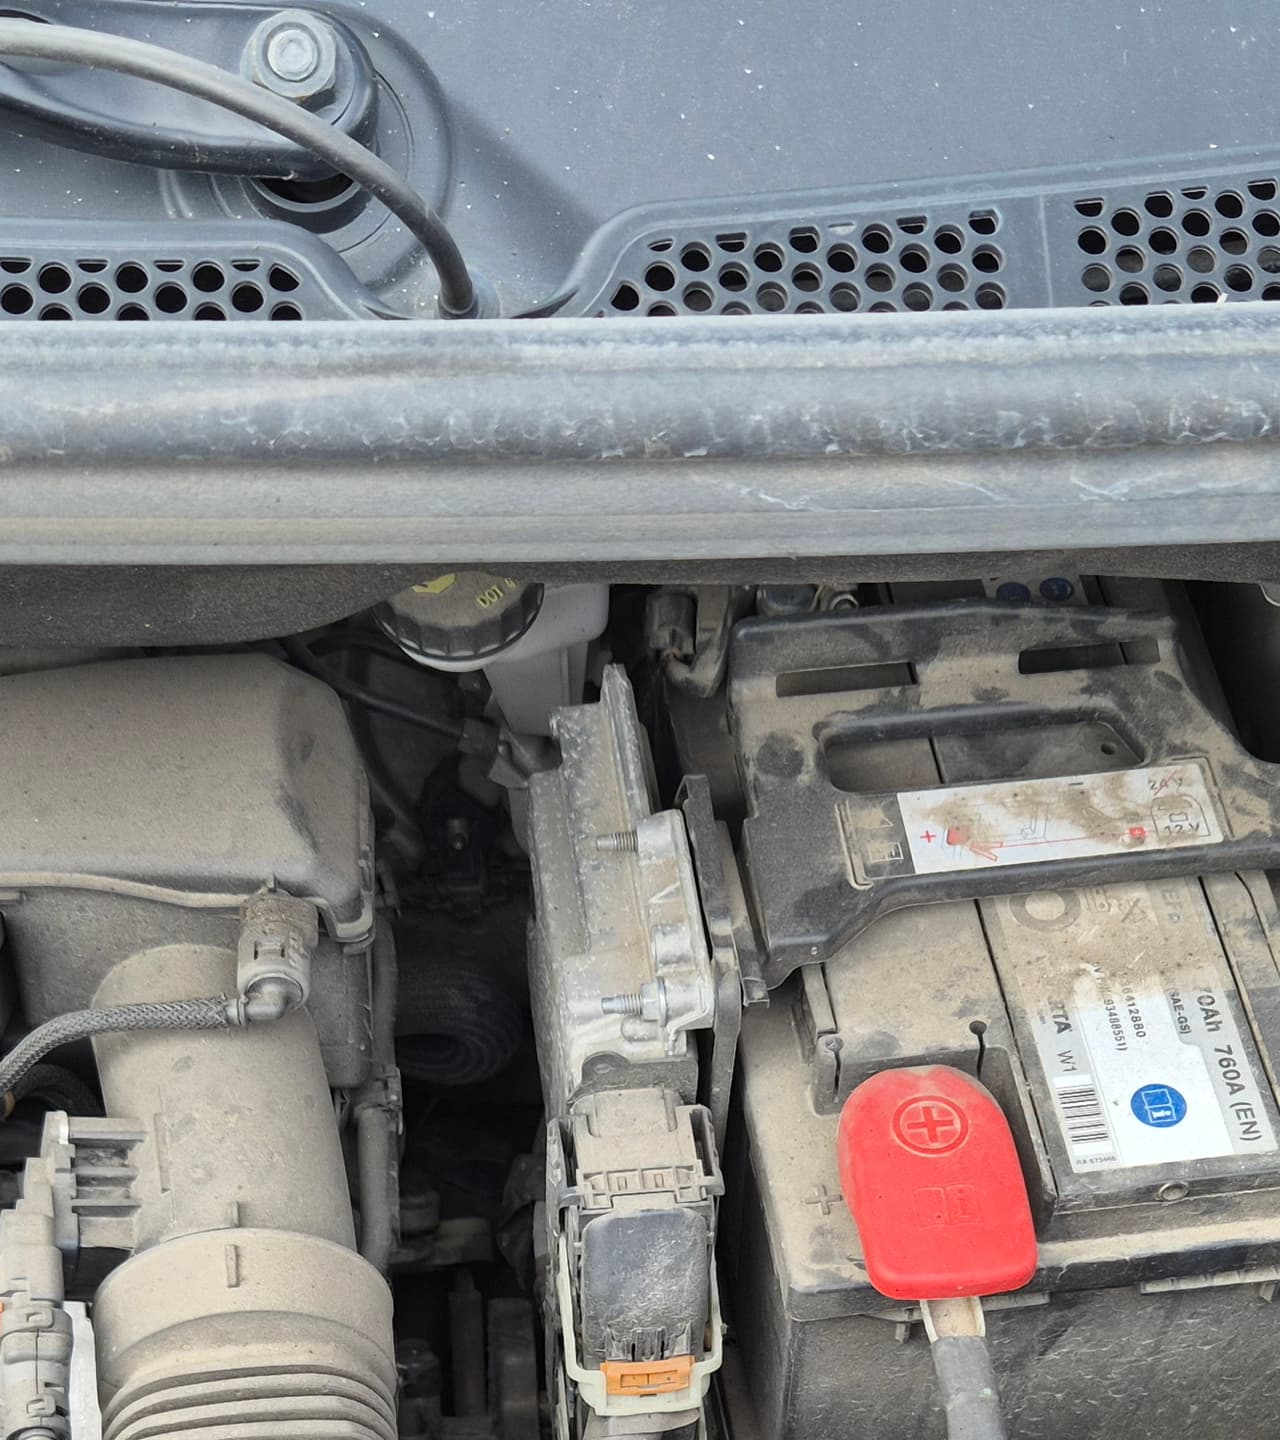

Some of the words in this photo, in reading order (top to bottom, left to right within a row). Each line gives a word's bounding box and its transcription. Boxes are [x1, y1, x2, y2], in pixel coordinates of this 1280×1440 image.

[475, 583, 505, 609] DOT
[1057, 1049, 1077, 1072] W1
[1214, 1044, 1246, 1096] 760A
[1229, 1101, 1262, 1142] (EN)
